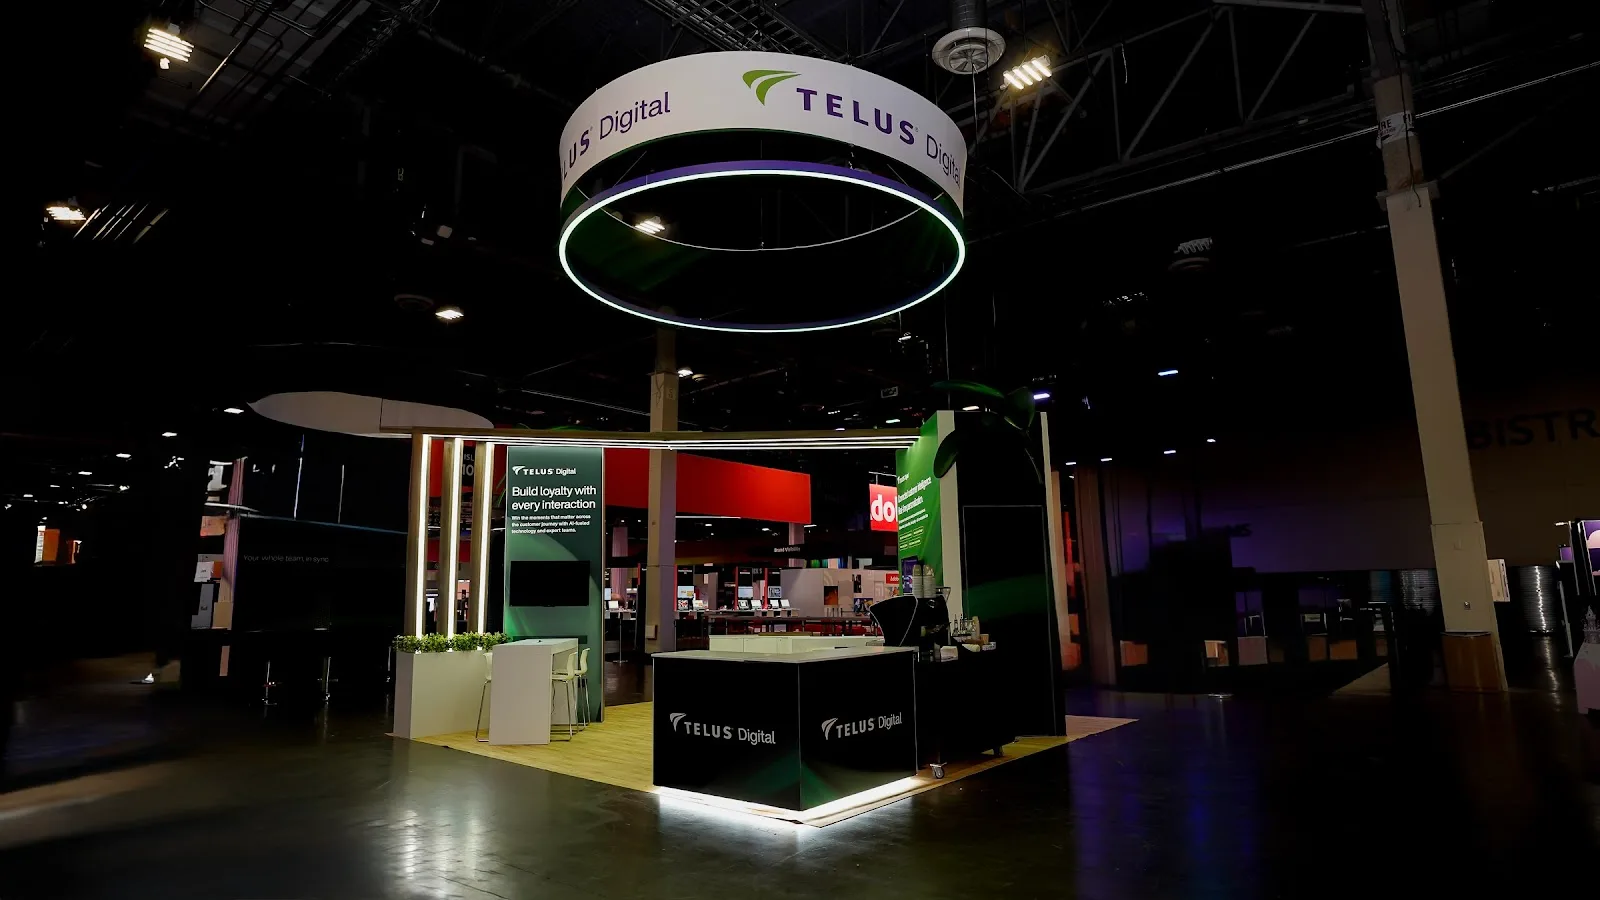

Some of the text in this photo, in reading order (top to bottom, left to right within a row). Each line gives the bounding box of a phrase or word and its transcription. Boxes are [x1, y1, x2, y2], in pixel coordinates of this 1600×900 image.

[563, 91, 671, 180] LUS Digital
[796, 88, 961, 189] TELUS Digital
[556, 468, 577, 476] Digital
[512, 485, 596, 498] Build loyalty with
[512, 499, 596, 512] every interaction
[870, 494, 898, 522] do
[261, 554, 284, 562] whole
[683, 721, 776, 745] TELUS Digital
[836, 711, 902, 738] TELUS Digital
